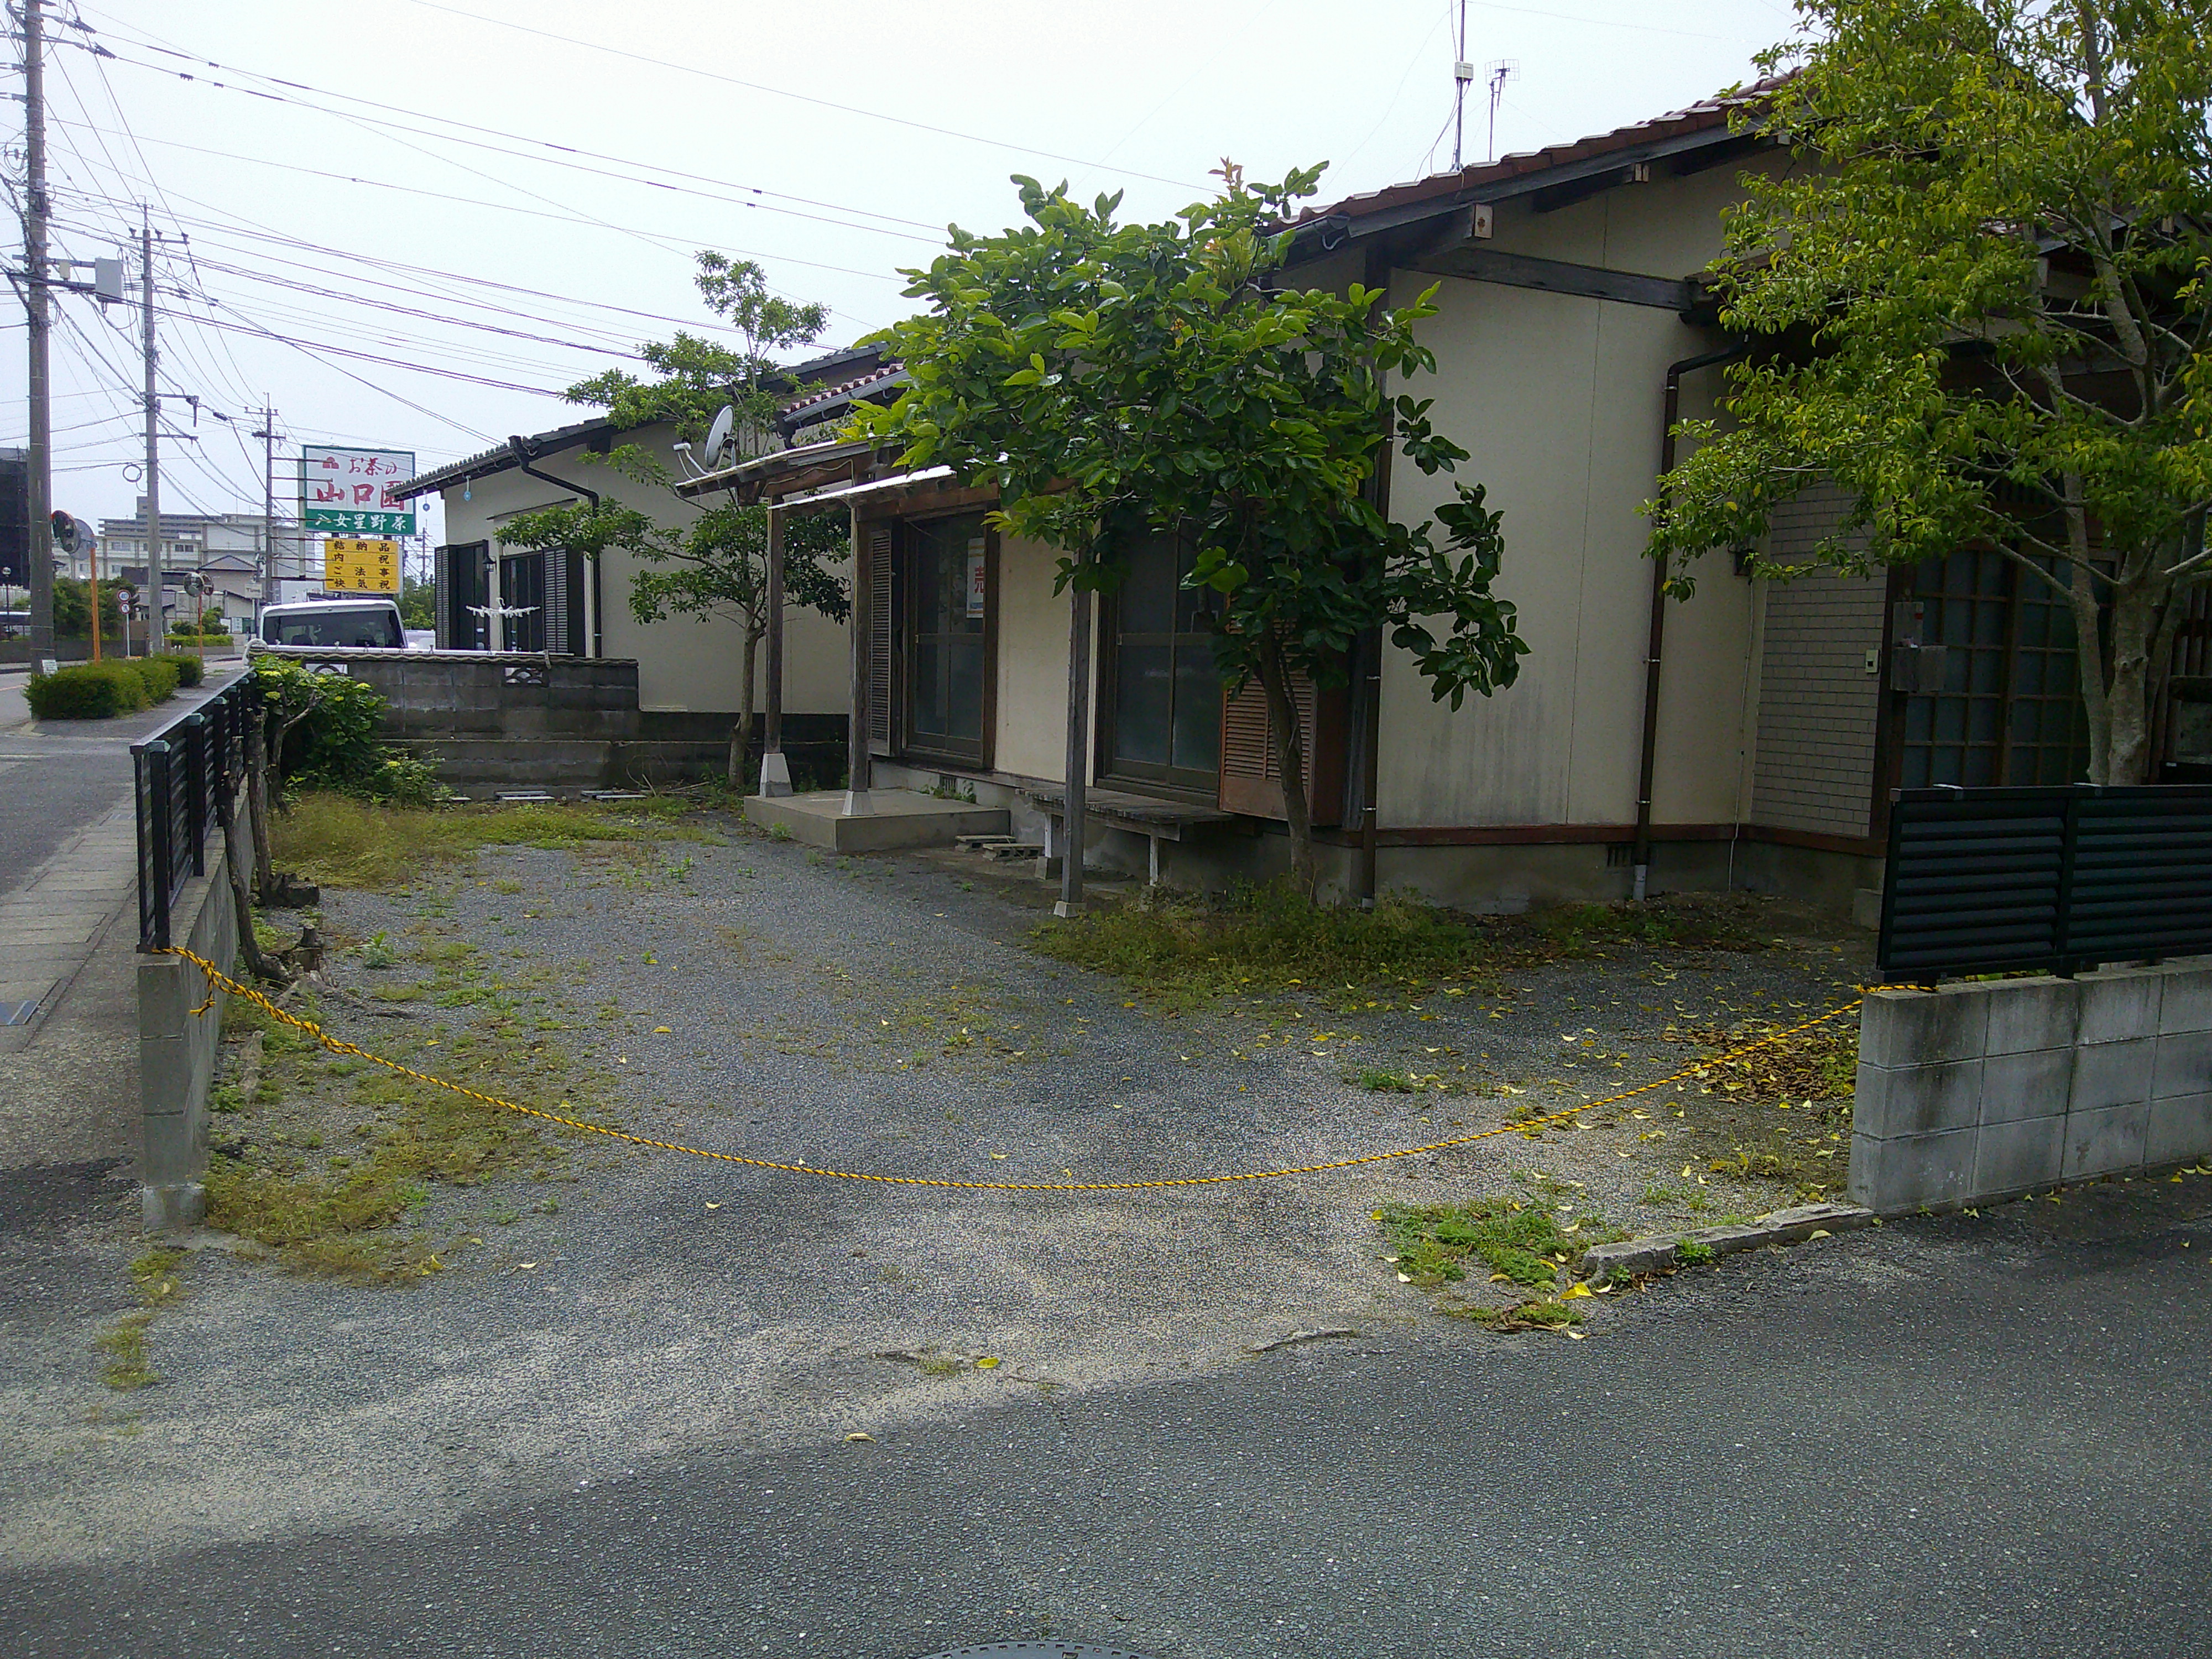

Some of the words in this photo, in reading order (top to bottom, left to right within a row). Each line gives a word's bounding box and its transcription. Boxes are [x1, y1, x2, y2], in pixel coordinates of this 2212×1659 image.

[348, 457, 397, 476] お茶の
[315, 513, 406, 531] 八女星野茶
[335, 578, 390, 589] 快気祝
